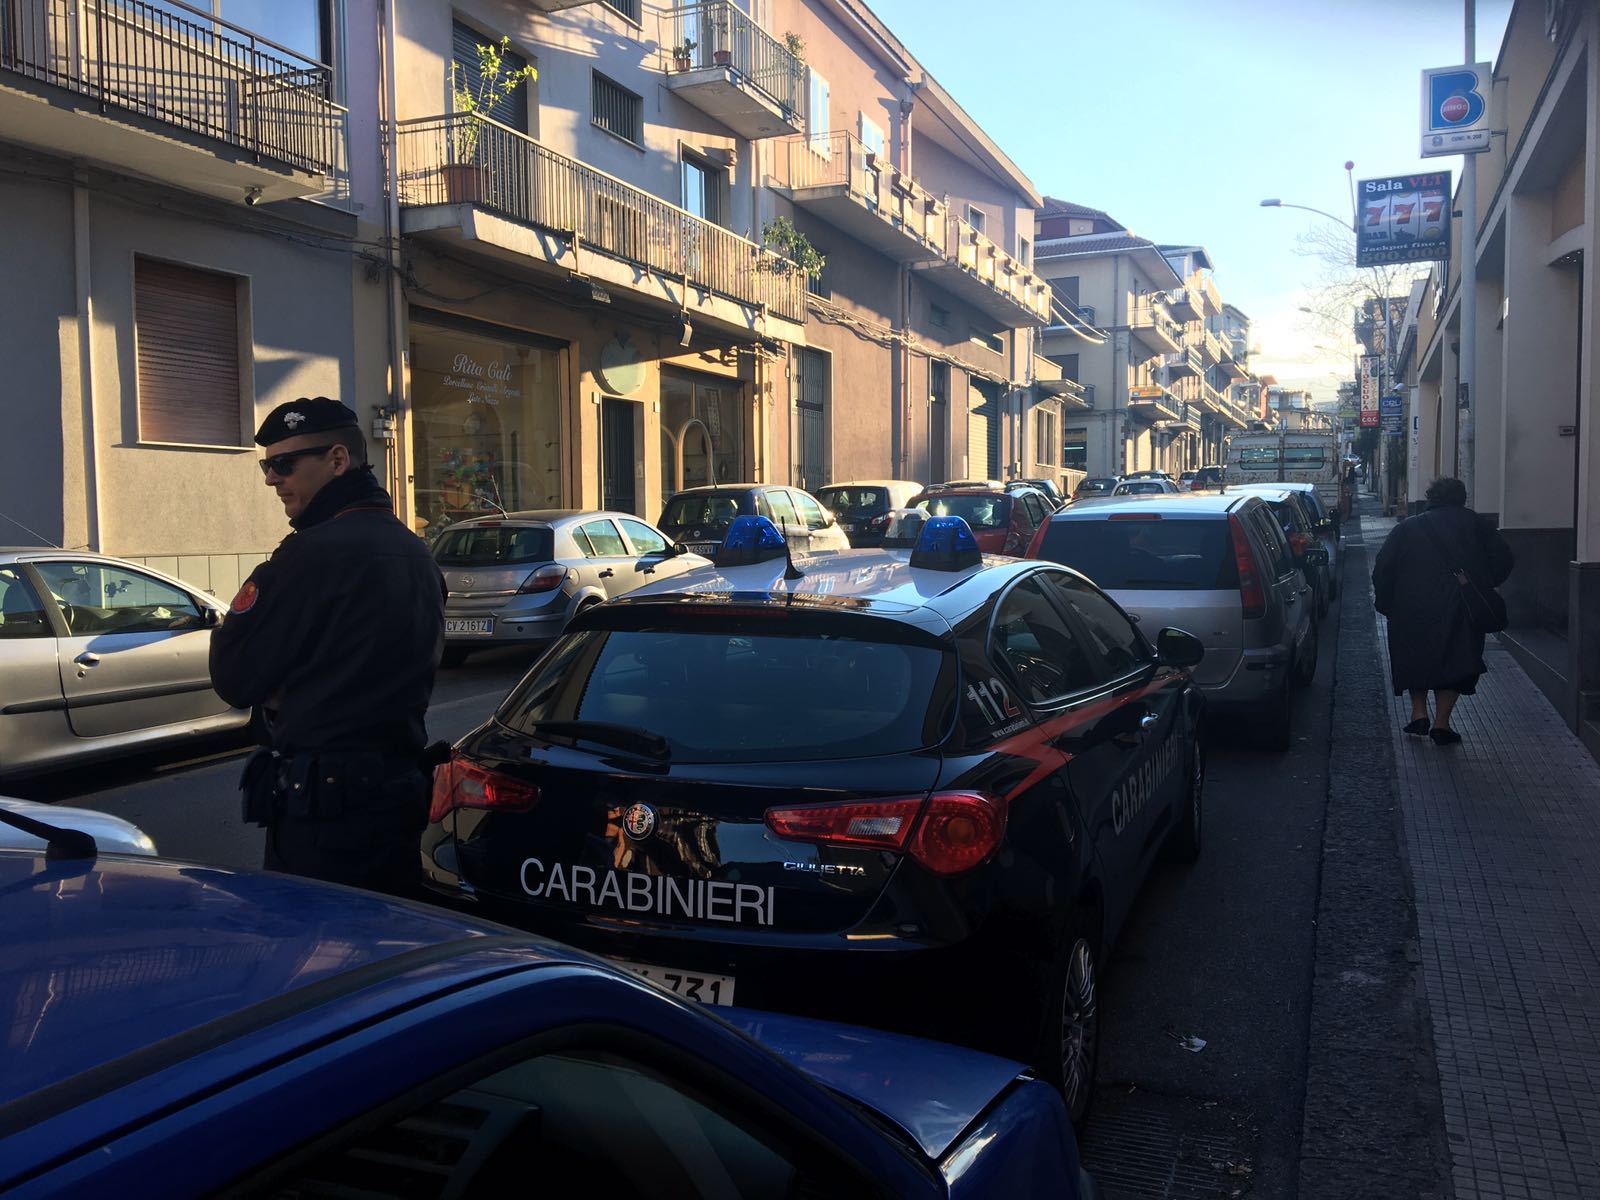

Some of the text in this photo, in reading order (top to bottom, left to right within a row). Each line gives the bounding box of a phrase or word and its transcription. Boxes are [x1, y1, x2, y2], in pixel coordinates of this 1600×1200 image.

[1365, 180, 1403, 193] Sala
[1362, 244, 1408, 253] Jackpot
[453, 353, 483, 377] Rita
[967, 677, 1021, 726] 112
[1112, 734, 1179, 837] CARABINIERI
[783, 861, 866, 876] GIULIETTA
[520, 857, 775, 925] CARABINIERI
[664, 973, 721, 1005] 731
